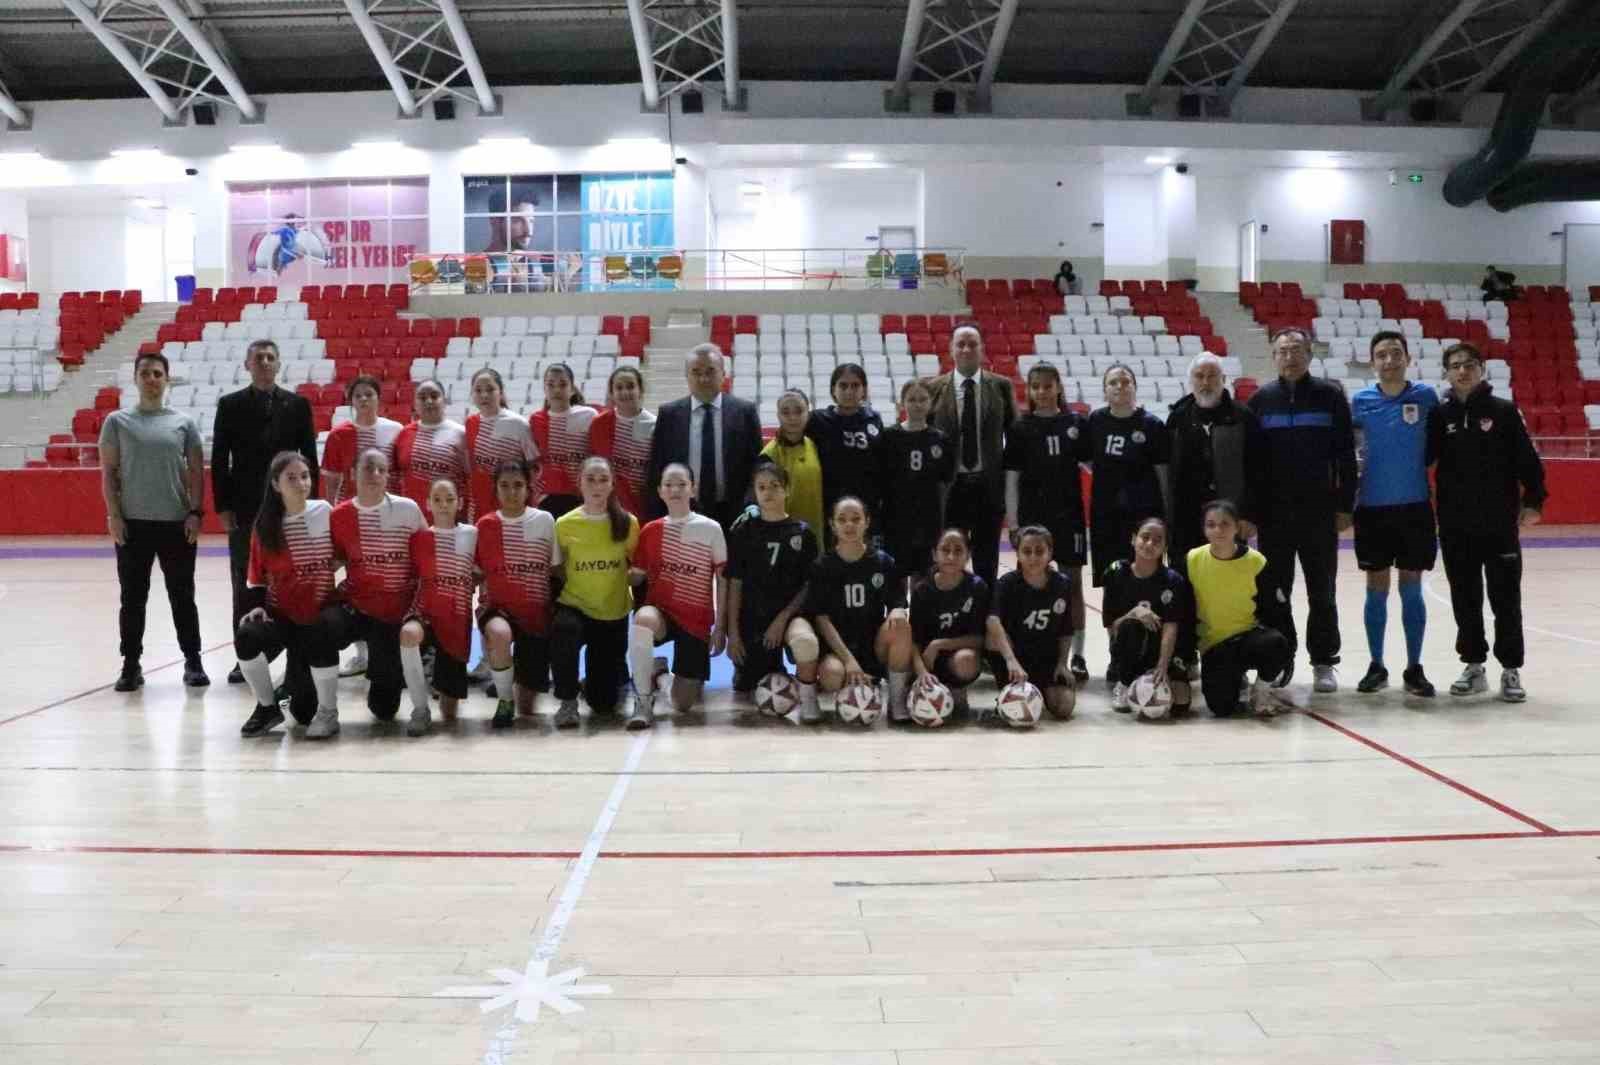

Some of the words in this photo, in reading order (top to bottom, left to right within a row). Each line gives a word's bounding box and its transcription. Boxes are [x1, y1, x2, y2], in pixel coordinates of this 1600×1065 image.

[1046, 435, 1060, 455] 11
[1104, 434, 1126, 456] 12
[910, 450, 923, 471] 8
[767, 542, 780, 566] 7
[844, 583, 866, 608] 10
[1023, 608, 1051, 631] 45
